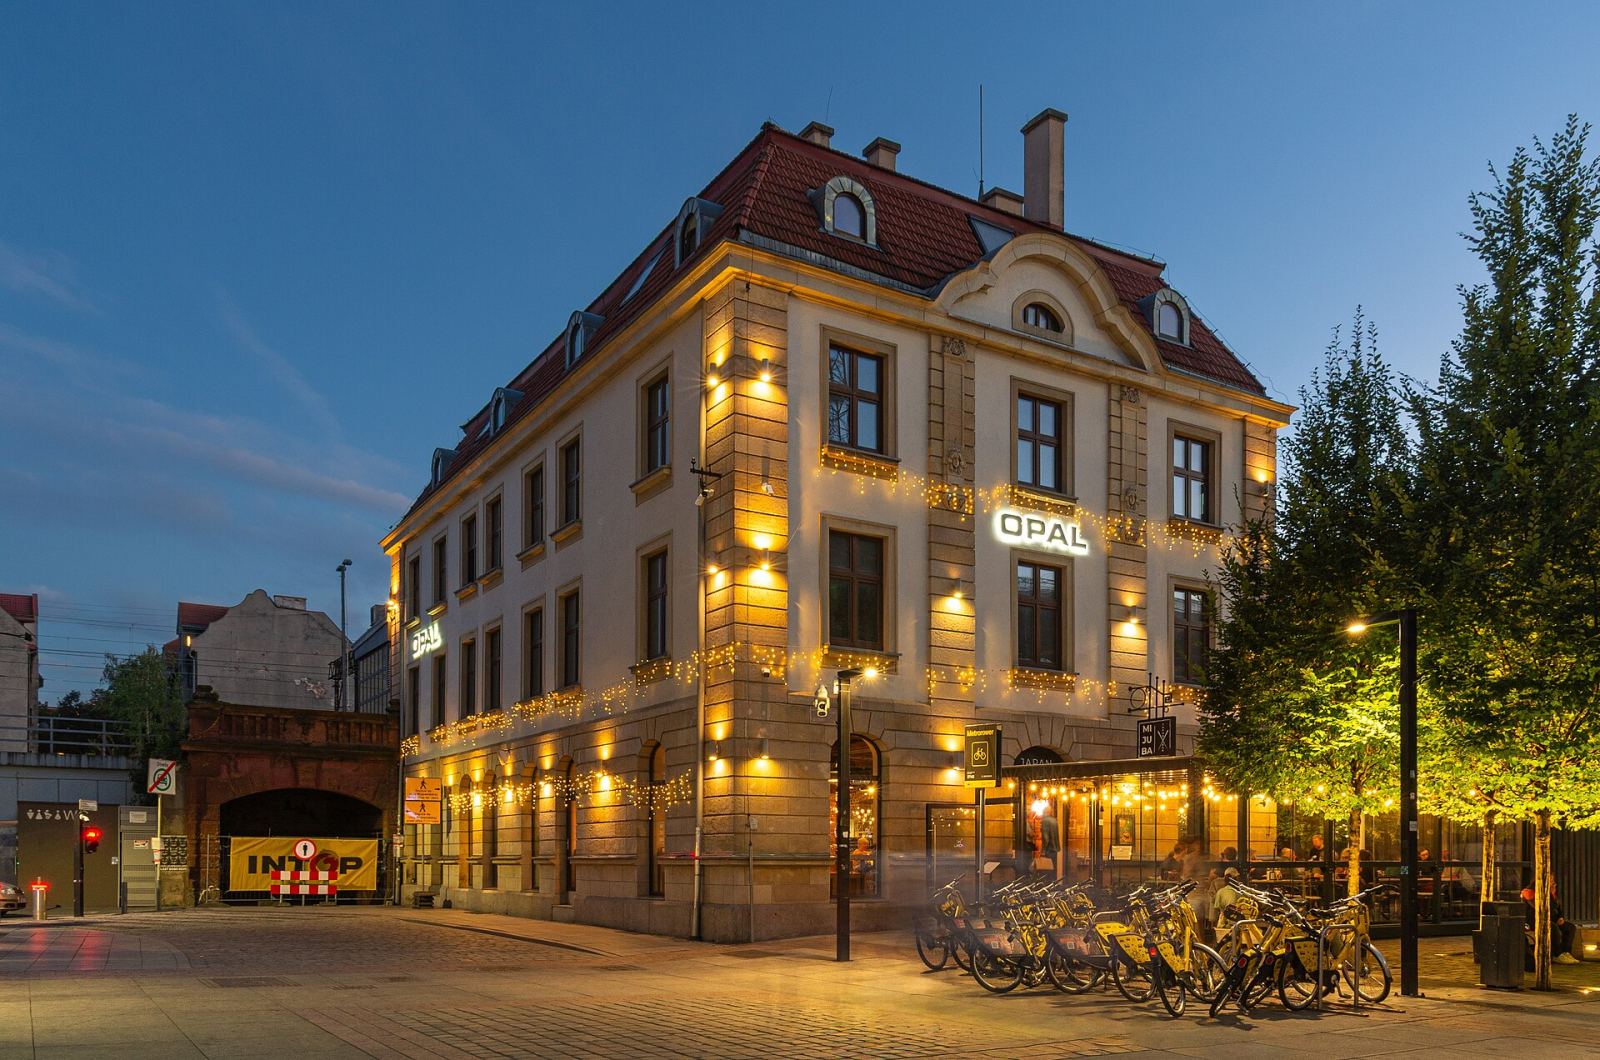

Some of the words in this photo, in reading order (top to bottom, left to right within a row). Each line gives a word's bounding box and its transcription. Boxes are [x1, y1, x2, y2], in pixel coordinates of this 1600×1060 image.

[1001, 513, 1087, 549] OPAL
[412, 622, 441, 658] OPAL
[1142, 724, 1153, 733] MI
[1142, 735, 1153, 745] JU
[1141, 746, 1153, 756] BA
